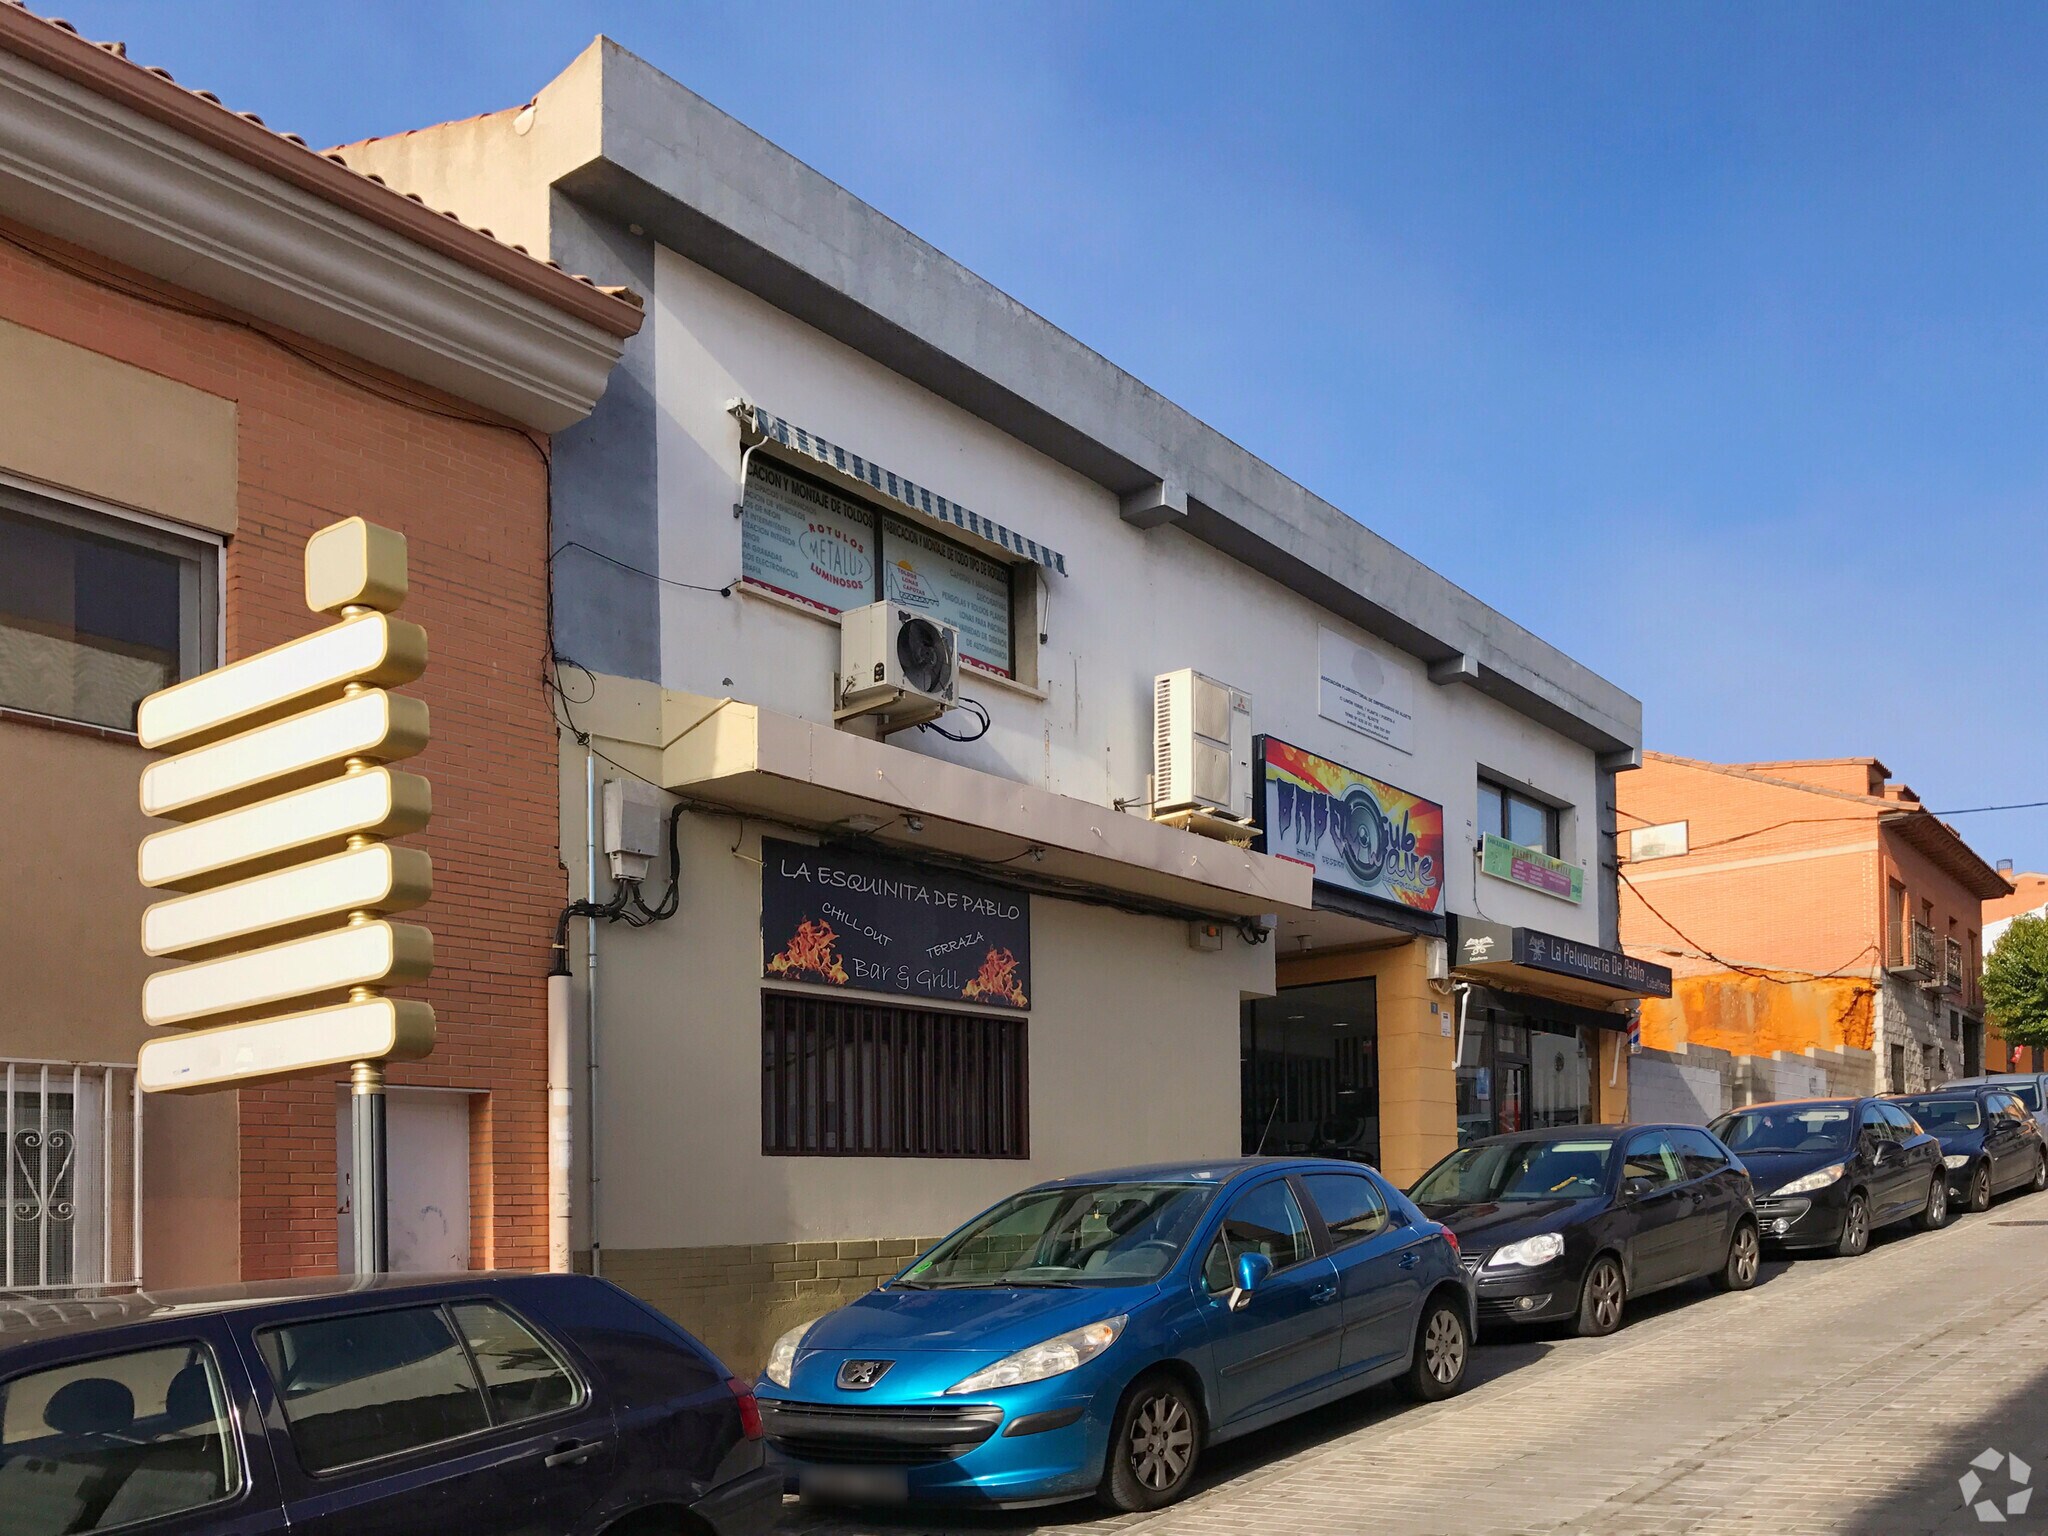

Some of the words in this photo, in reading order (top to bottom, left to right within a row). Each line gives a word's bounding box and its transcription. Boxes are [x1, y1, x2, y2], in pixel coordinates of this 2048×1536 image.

[782, 478, 788, 491] Y
[791, 482, 829, 509] MONTAJE
[829, 499, 841, 514] DE
[842, 504, 873, 528] TOLDOS
[808, 523, 864, 553] ROTULOS
[810, 562, 864, 589] LUMINOSOS
[902, 584, 926, 597] CAPOTAS
[780, 859, 811, 883] LA
[818, 866, 930, 905] ESQUINITA
[934, 889, 958, 909] DE
[962, 894, 1020, 921] PABLO
[821, 902, 861, 932] CHILL
[863, 925, 893, 948] OUT
[926, 931, 984, 959] TERRAZA
[1550, 939, 1562, 962] La
[1563, 942, 1610, 975] Peluquería
[1611, 955, 1622, 977] De
[1624, 958, 1645, 983] Pablo
[852, 957, 891, 982] Bar
[896, 964, 910, 990] &
[916, 969, 960, 991] Grill
